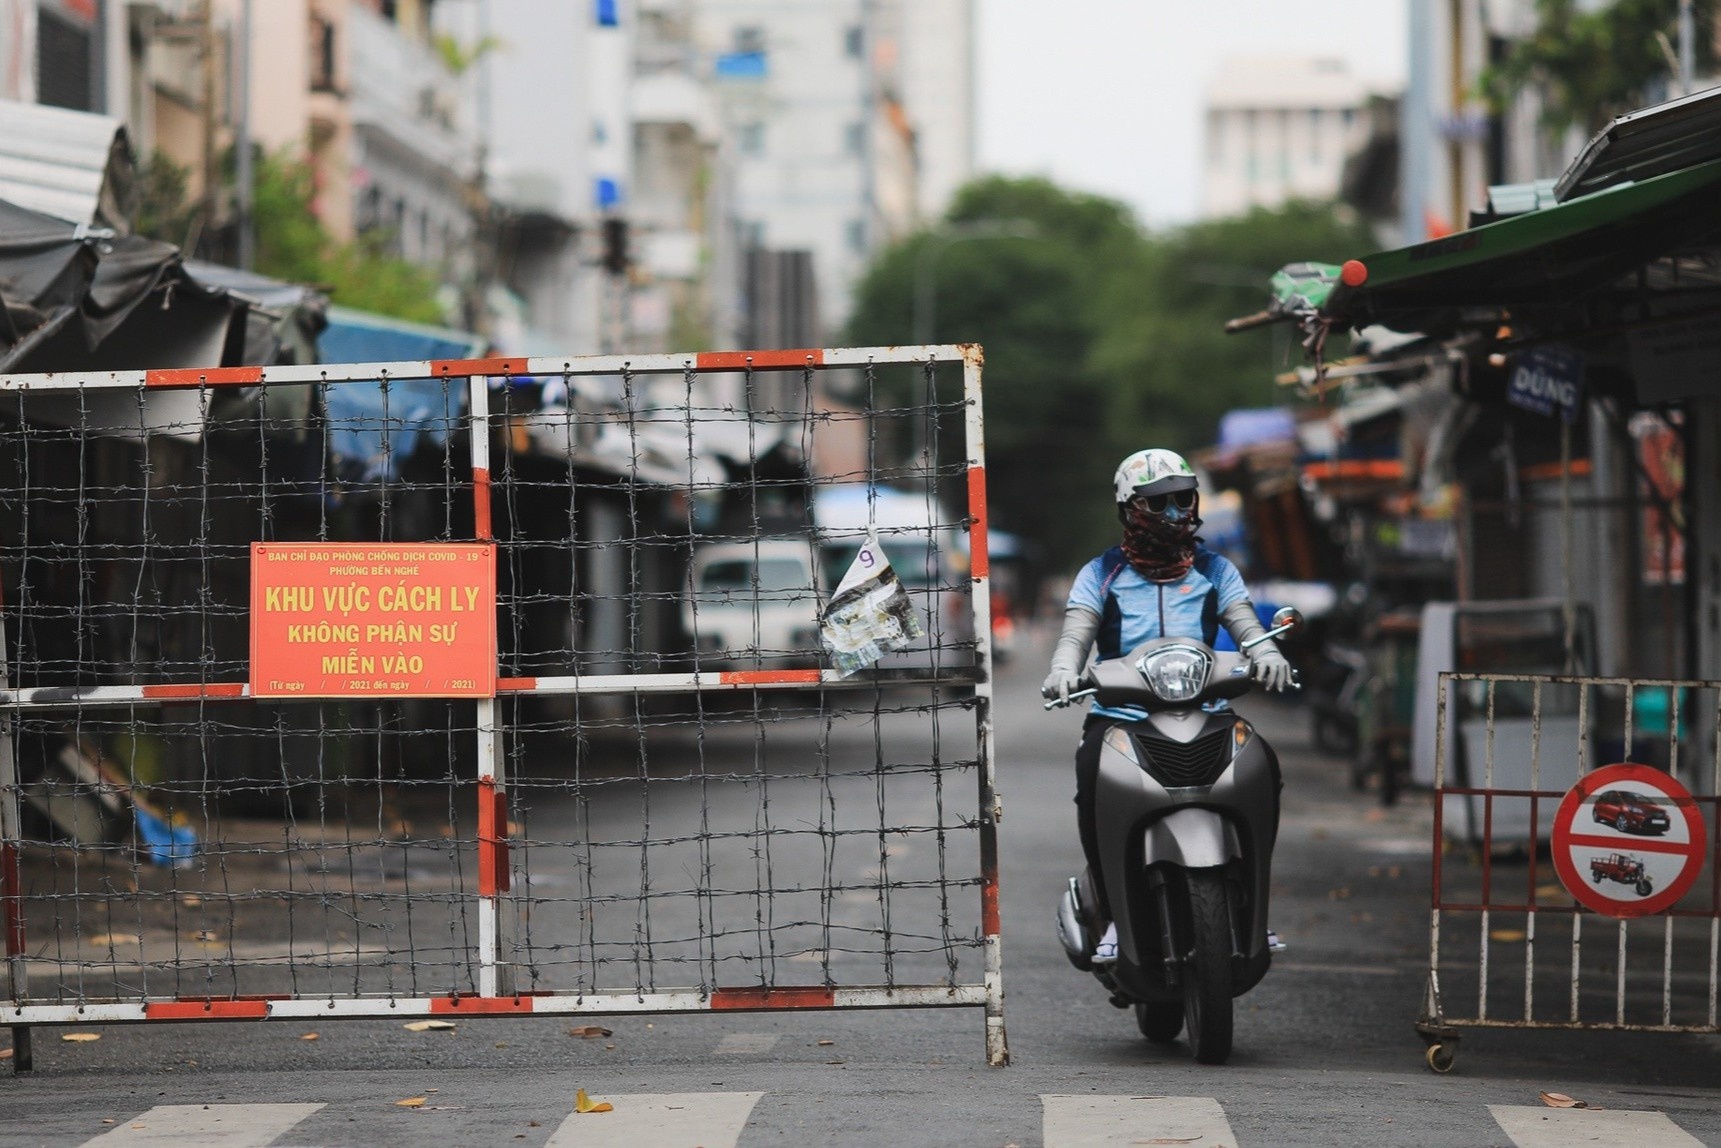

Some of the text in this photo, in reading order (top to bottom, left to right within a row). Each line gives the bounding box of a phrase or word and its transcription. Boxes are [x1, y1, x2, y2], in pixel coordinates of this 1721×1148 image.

[268, 552, 288, 561] BAN
[291, 550, 307, 561] CHỈ
[310, 552, 329, 563] ĐẠO
[332, 550, 365, 561] PHÒNG
[368, 549, 401, 561] CHỐNG
[403, 551, 426, 563] DỊCH
[428, 552, 457, 562] COVID
[466, 552, 479, 562] 19
[859, 549, 875, 569] 9
[329, 564, 420, 576] PHƯỜNG BẾN NGHÉ
[265, 579, 480, 617] KHU VỰC CÁCH LY
[288, 619, 458, 646] KHÔNG PHẬN SỰ
[322, 647, 424, 675] MIỄN VÀO
[269, 680, 285, 690] (Từ
[285, 680, 305, 692] ngày
[349, 680, 370, 690] 2021
[373, 679, 388, 690] đến
[390, 680, 410, 692] ngày
[451, 679, 476, 690] 2021)
